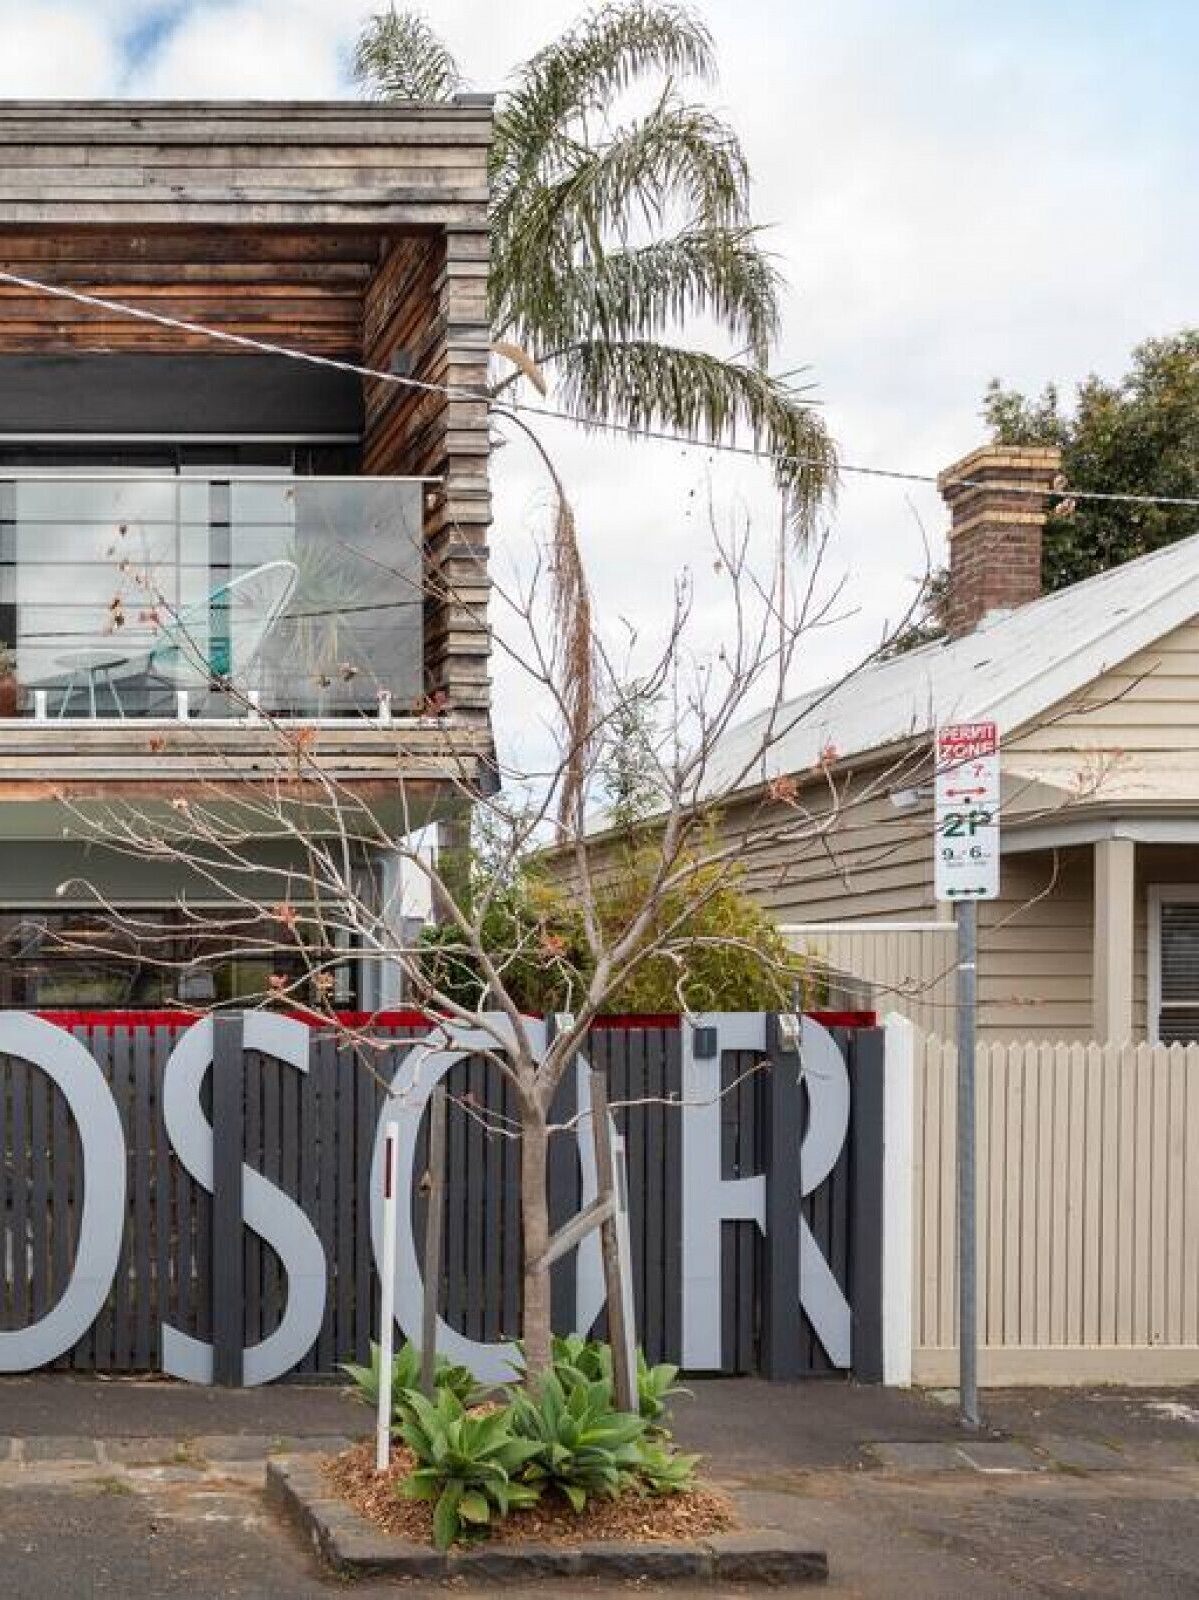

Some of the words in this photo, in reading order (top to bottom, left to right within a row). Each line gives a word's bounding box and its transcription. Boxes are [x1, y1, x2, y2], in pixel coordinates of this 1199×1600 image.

[940, 724, 995, 740] PERMIT
[940, 741, 995, 760] ZONE
[943, 810, 993, 837] 2P
